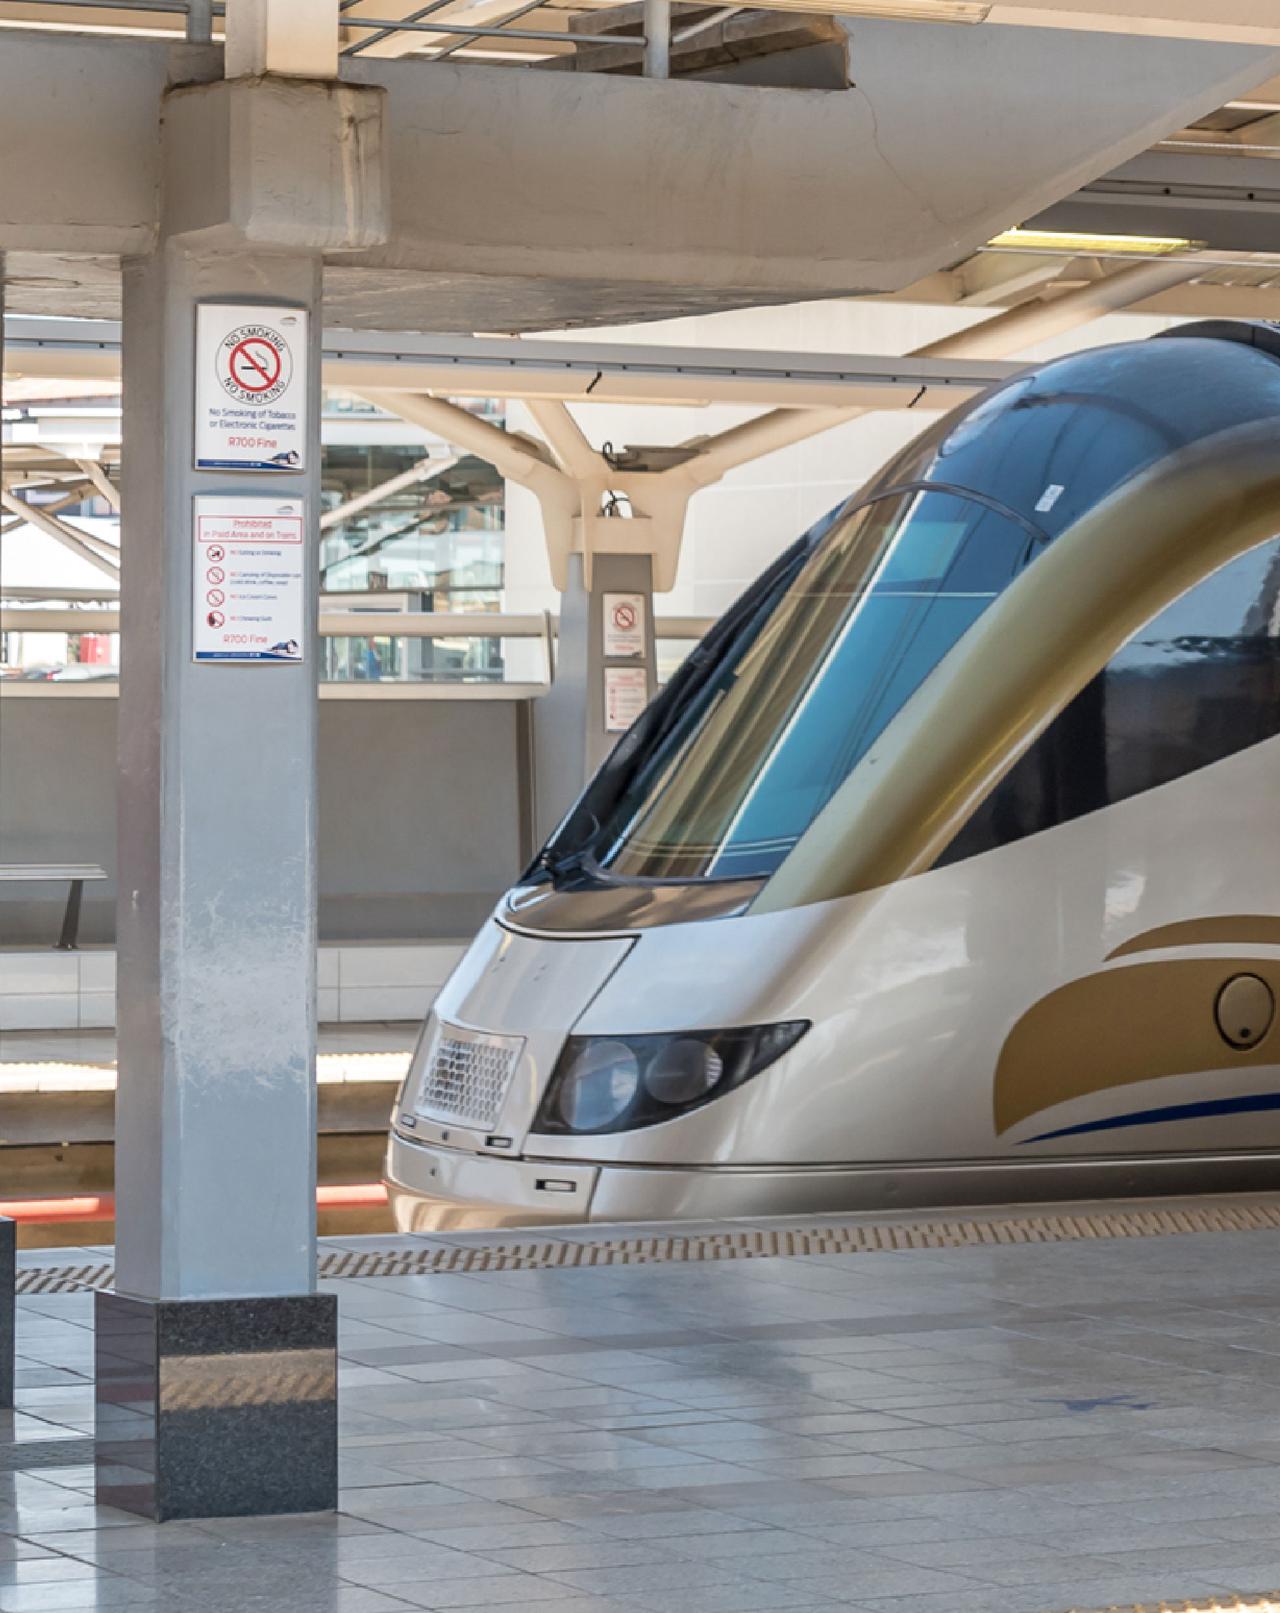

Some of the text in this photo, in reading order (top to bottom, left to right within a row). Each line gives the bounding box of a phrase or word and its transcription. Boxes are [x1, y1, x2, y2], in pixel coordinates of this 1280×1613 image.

[224, 327, 285, 352] NO SMOKING
[224, 377, 286, 403] NO SMOKING
[222, 408, 257, 419] Smoking
[258, 409, 268, 418] of
[220, 420, 258, 429] Electronic
[228, 436, 278, 448] R700 Fine
